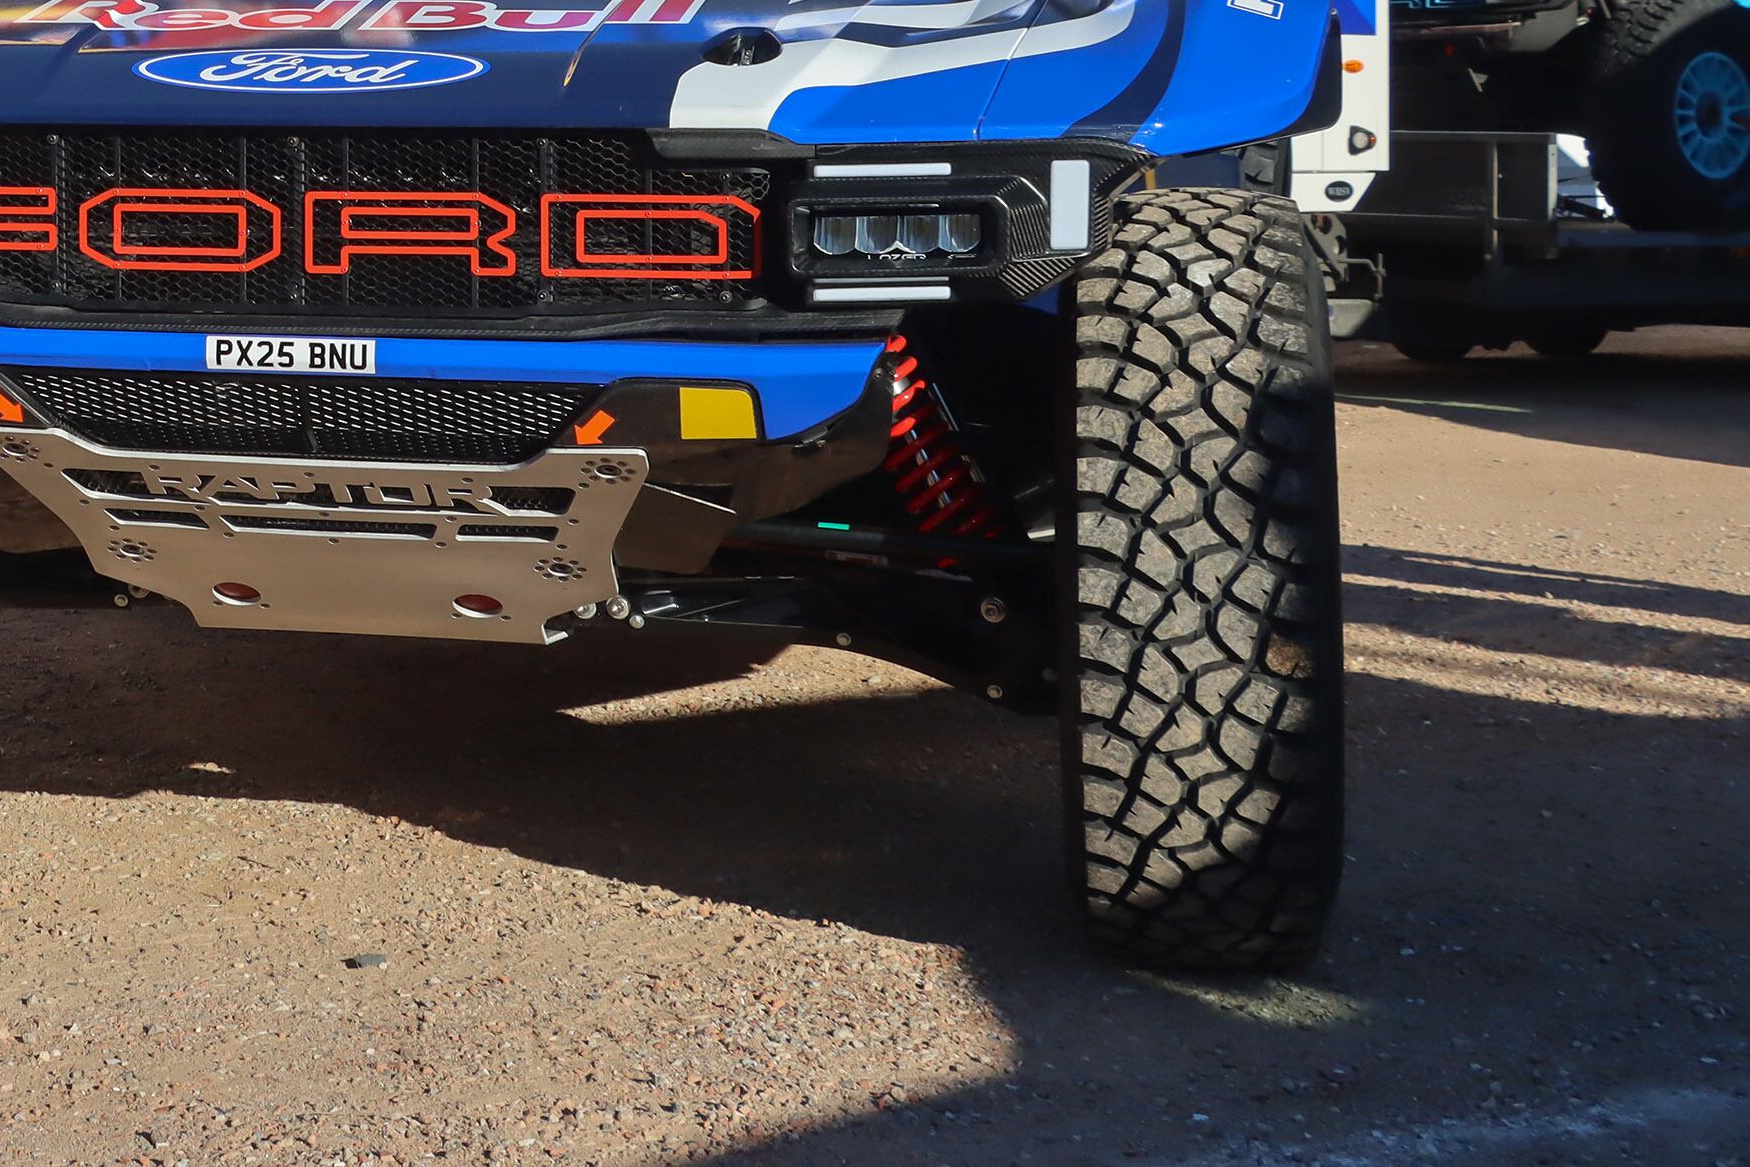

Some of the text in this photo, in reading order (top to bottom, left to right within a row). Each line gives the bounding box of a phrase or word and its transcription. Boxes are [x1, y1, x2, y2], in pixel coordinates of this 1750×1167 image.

[199, 51, 421, 87] Ford
[215, 339, 367, 371] PX25 BNU
[142, 471, 496, 516] RAPTOR
